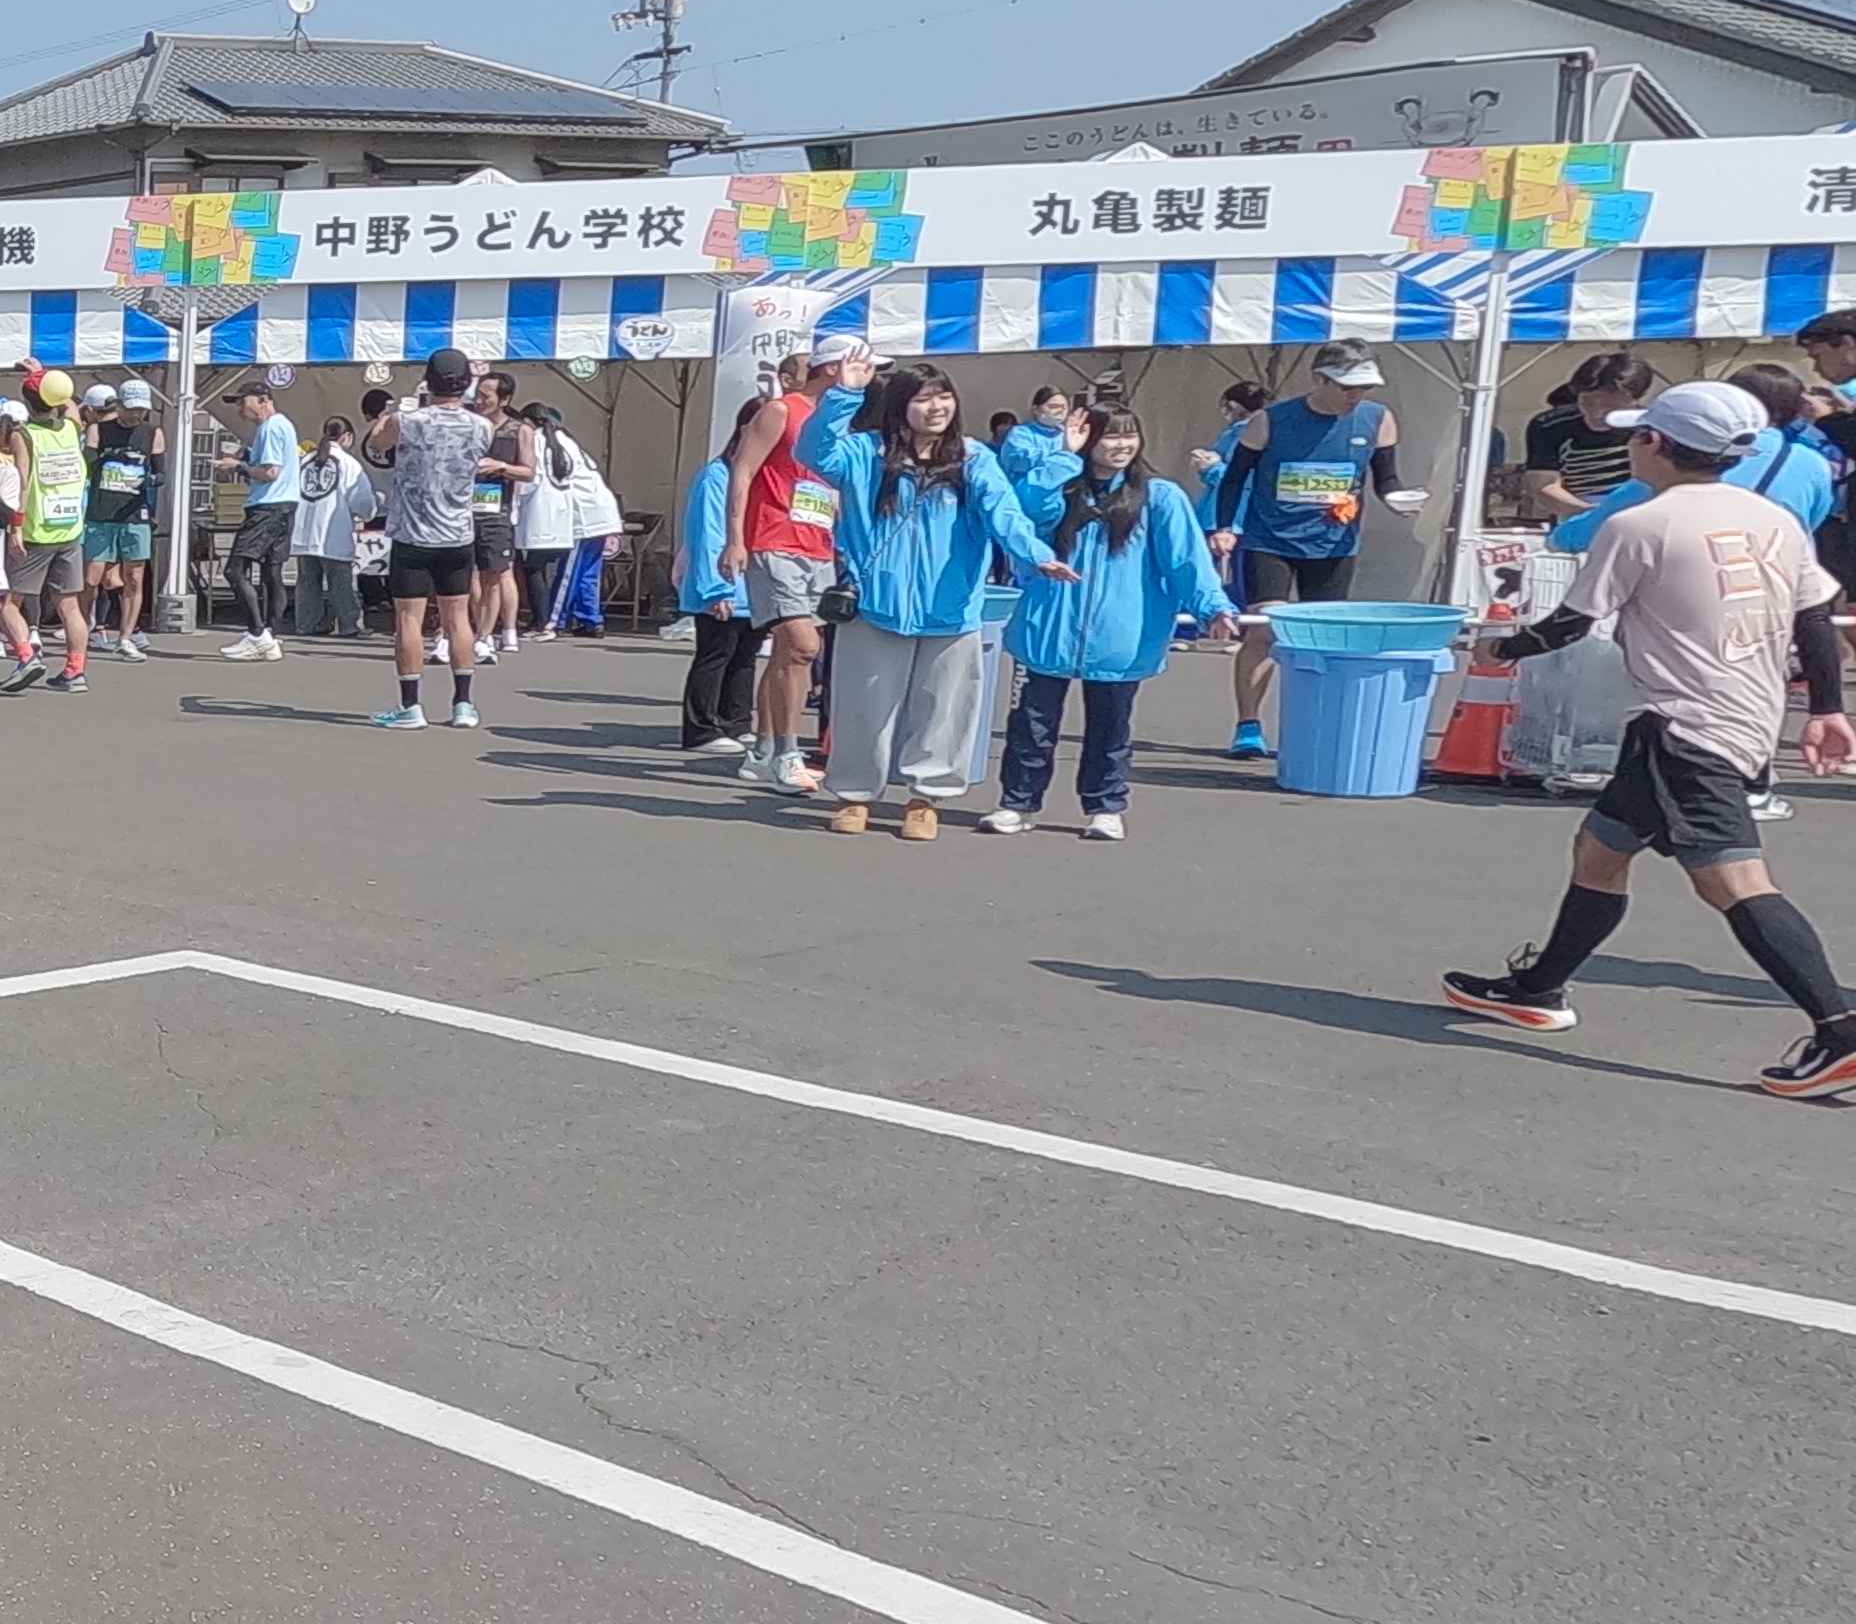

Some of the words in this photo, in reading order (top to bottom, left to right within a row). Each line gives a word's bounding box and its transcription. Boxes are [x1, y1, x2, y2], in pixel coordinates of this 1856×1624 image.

[1023, 102, 1331, 153] ここのうどんは、生きている。
[313, 202, 688, 258] 中野うどん学校
[1027, 184, 1274, 237] 丸亀製麺
